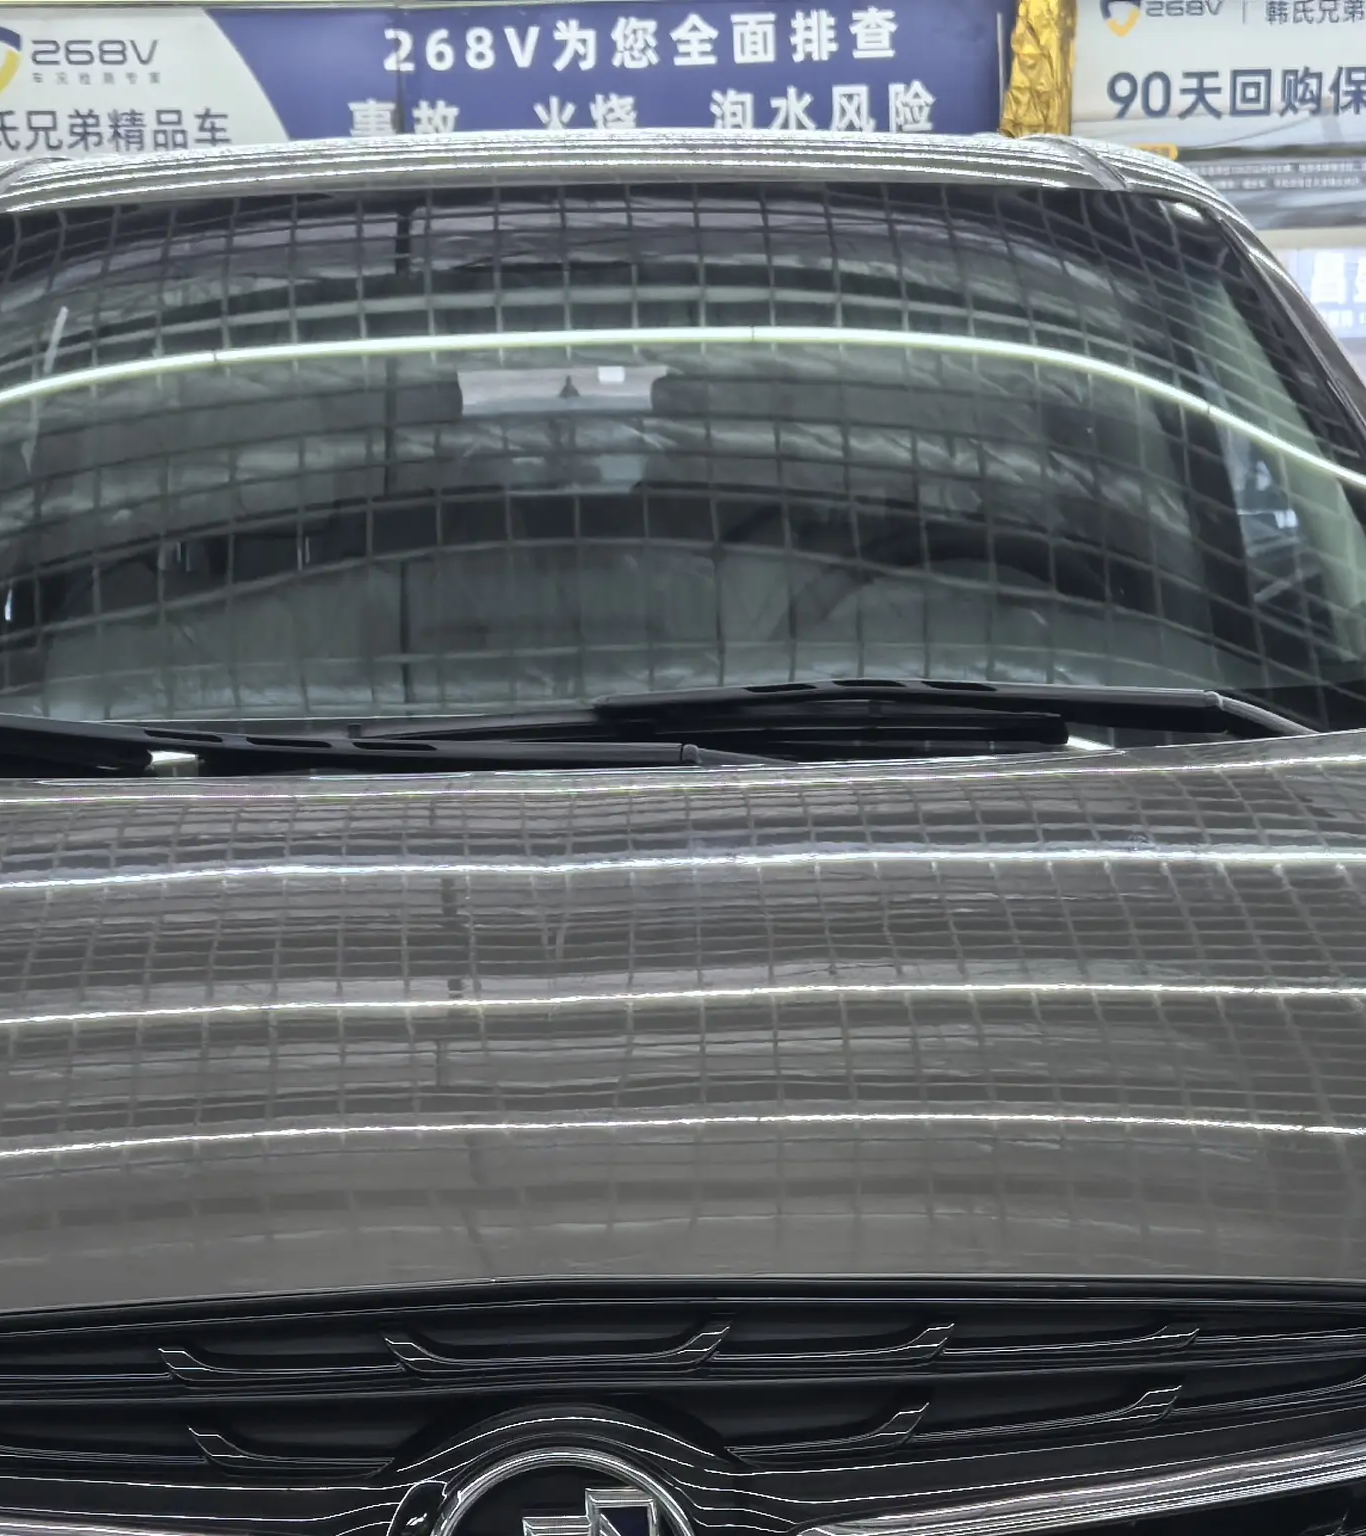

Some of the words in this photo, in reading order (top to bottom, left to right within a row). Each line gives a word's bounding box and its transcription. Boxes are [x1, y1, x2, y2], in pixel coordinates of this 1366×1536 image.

[31, 39, 160, 66] 268V
[382, 7, 898, 72] 268V为您全面排查
